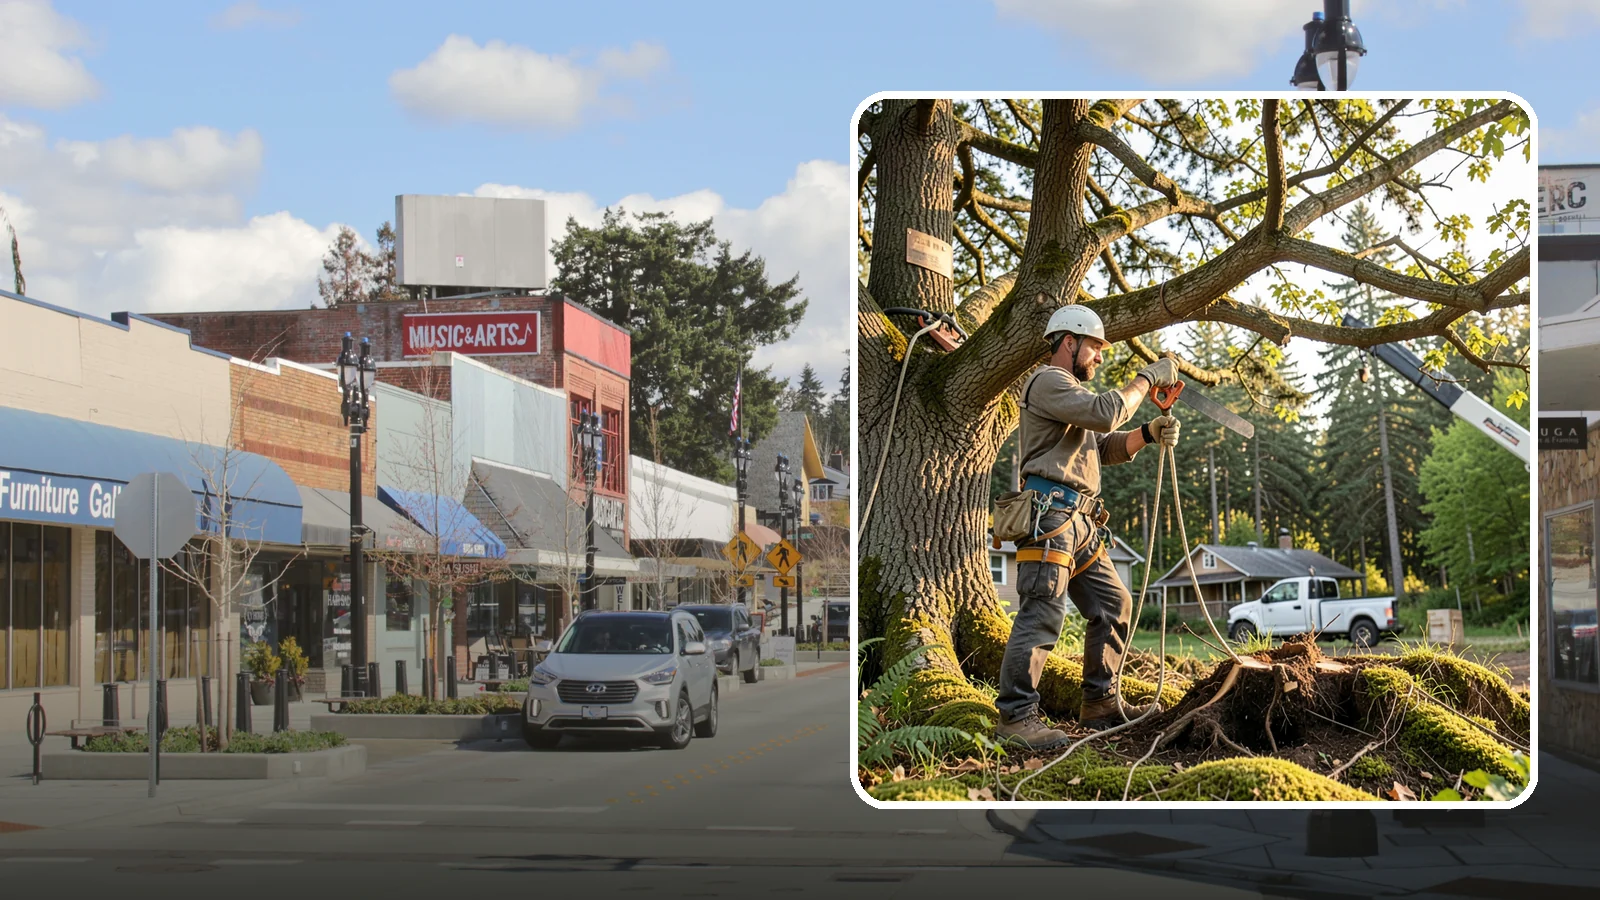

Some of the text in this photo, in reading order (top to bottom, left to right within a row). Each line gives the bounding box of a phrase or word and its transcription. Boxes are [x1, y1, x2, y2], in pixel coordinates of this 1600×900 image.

[408, 322, 520, 349] MUSIC&ARTS
[0, 471, 79, 515] Furniture
[453, 563, 479, 574] SUSHI
